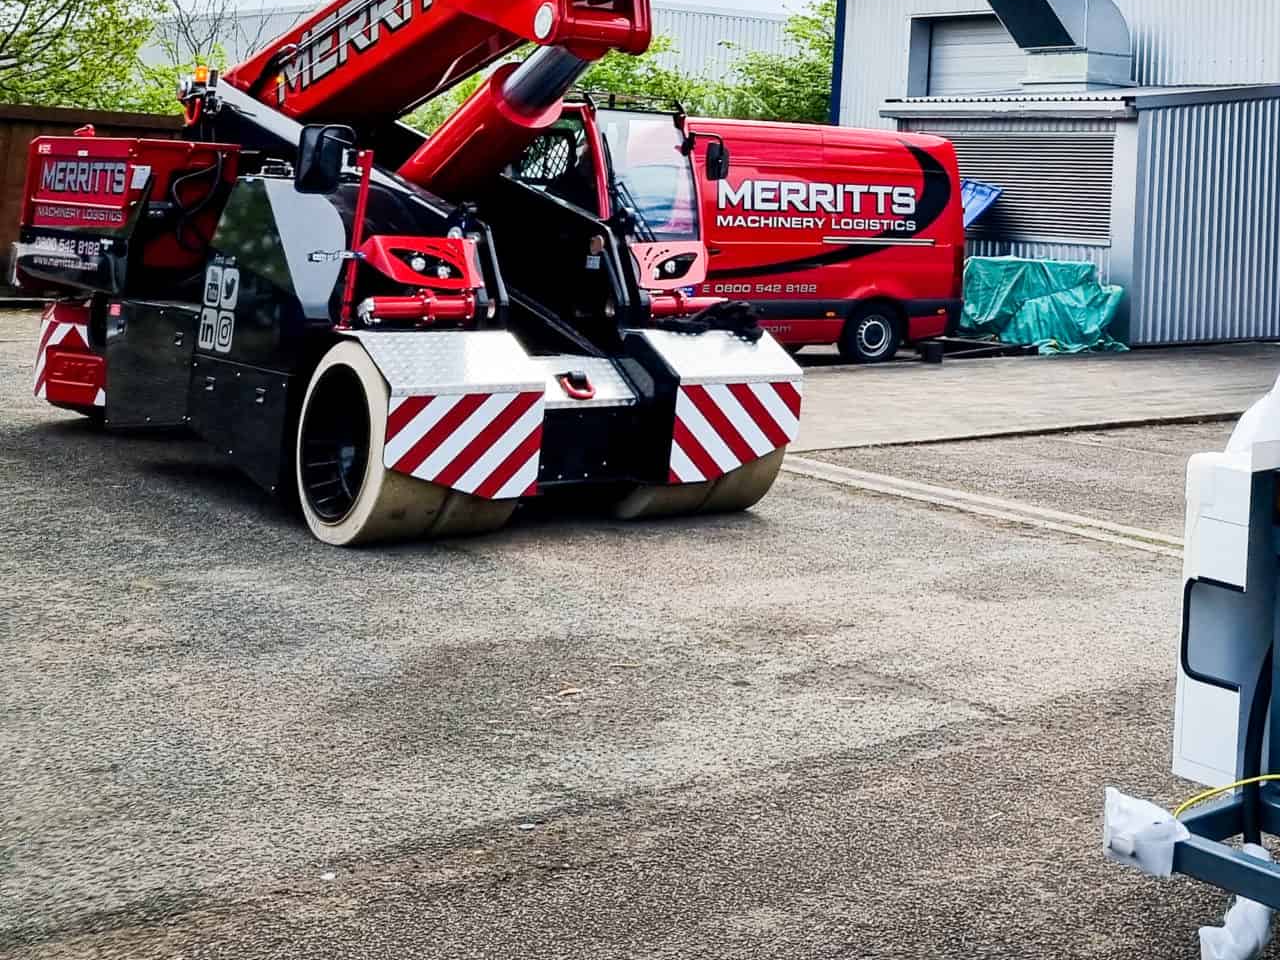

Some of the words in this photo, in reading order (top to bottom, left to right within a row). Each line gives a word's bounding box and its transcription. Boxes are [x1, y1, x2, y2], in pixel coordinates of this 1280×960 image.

[40, 160, 127, 194] MERRITTS
[717, 178, 916, 215] MERRITTS
[37, 206, 80, 219] MACHINERY
[82, 208, 123, 222] LOGISTICS
[716, 215, 825, 230] MACHINERY
[831, 217, 916, 232] LOGISTICS
[78, 240, 100, 256] 8182
[714, 283, 752, 293] 0800
[755, 283, 782, 293] 542
[785, 283, 817, 293] 8182
[200, 314, 215, 344] in
